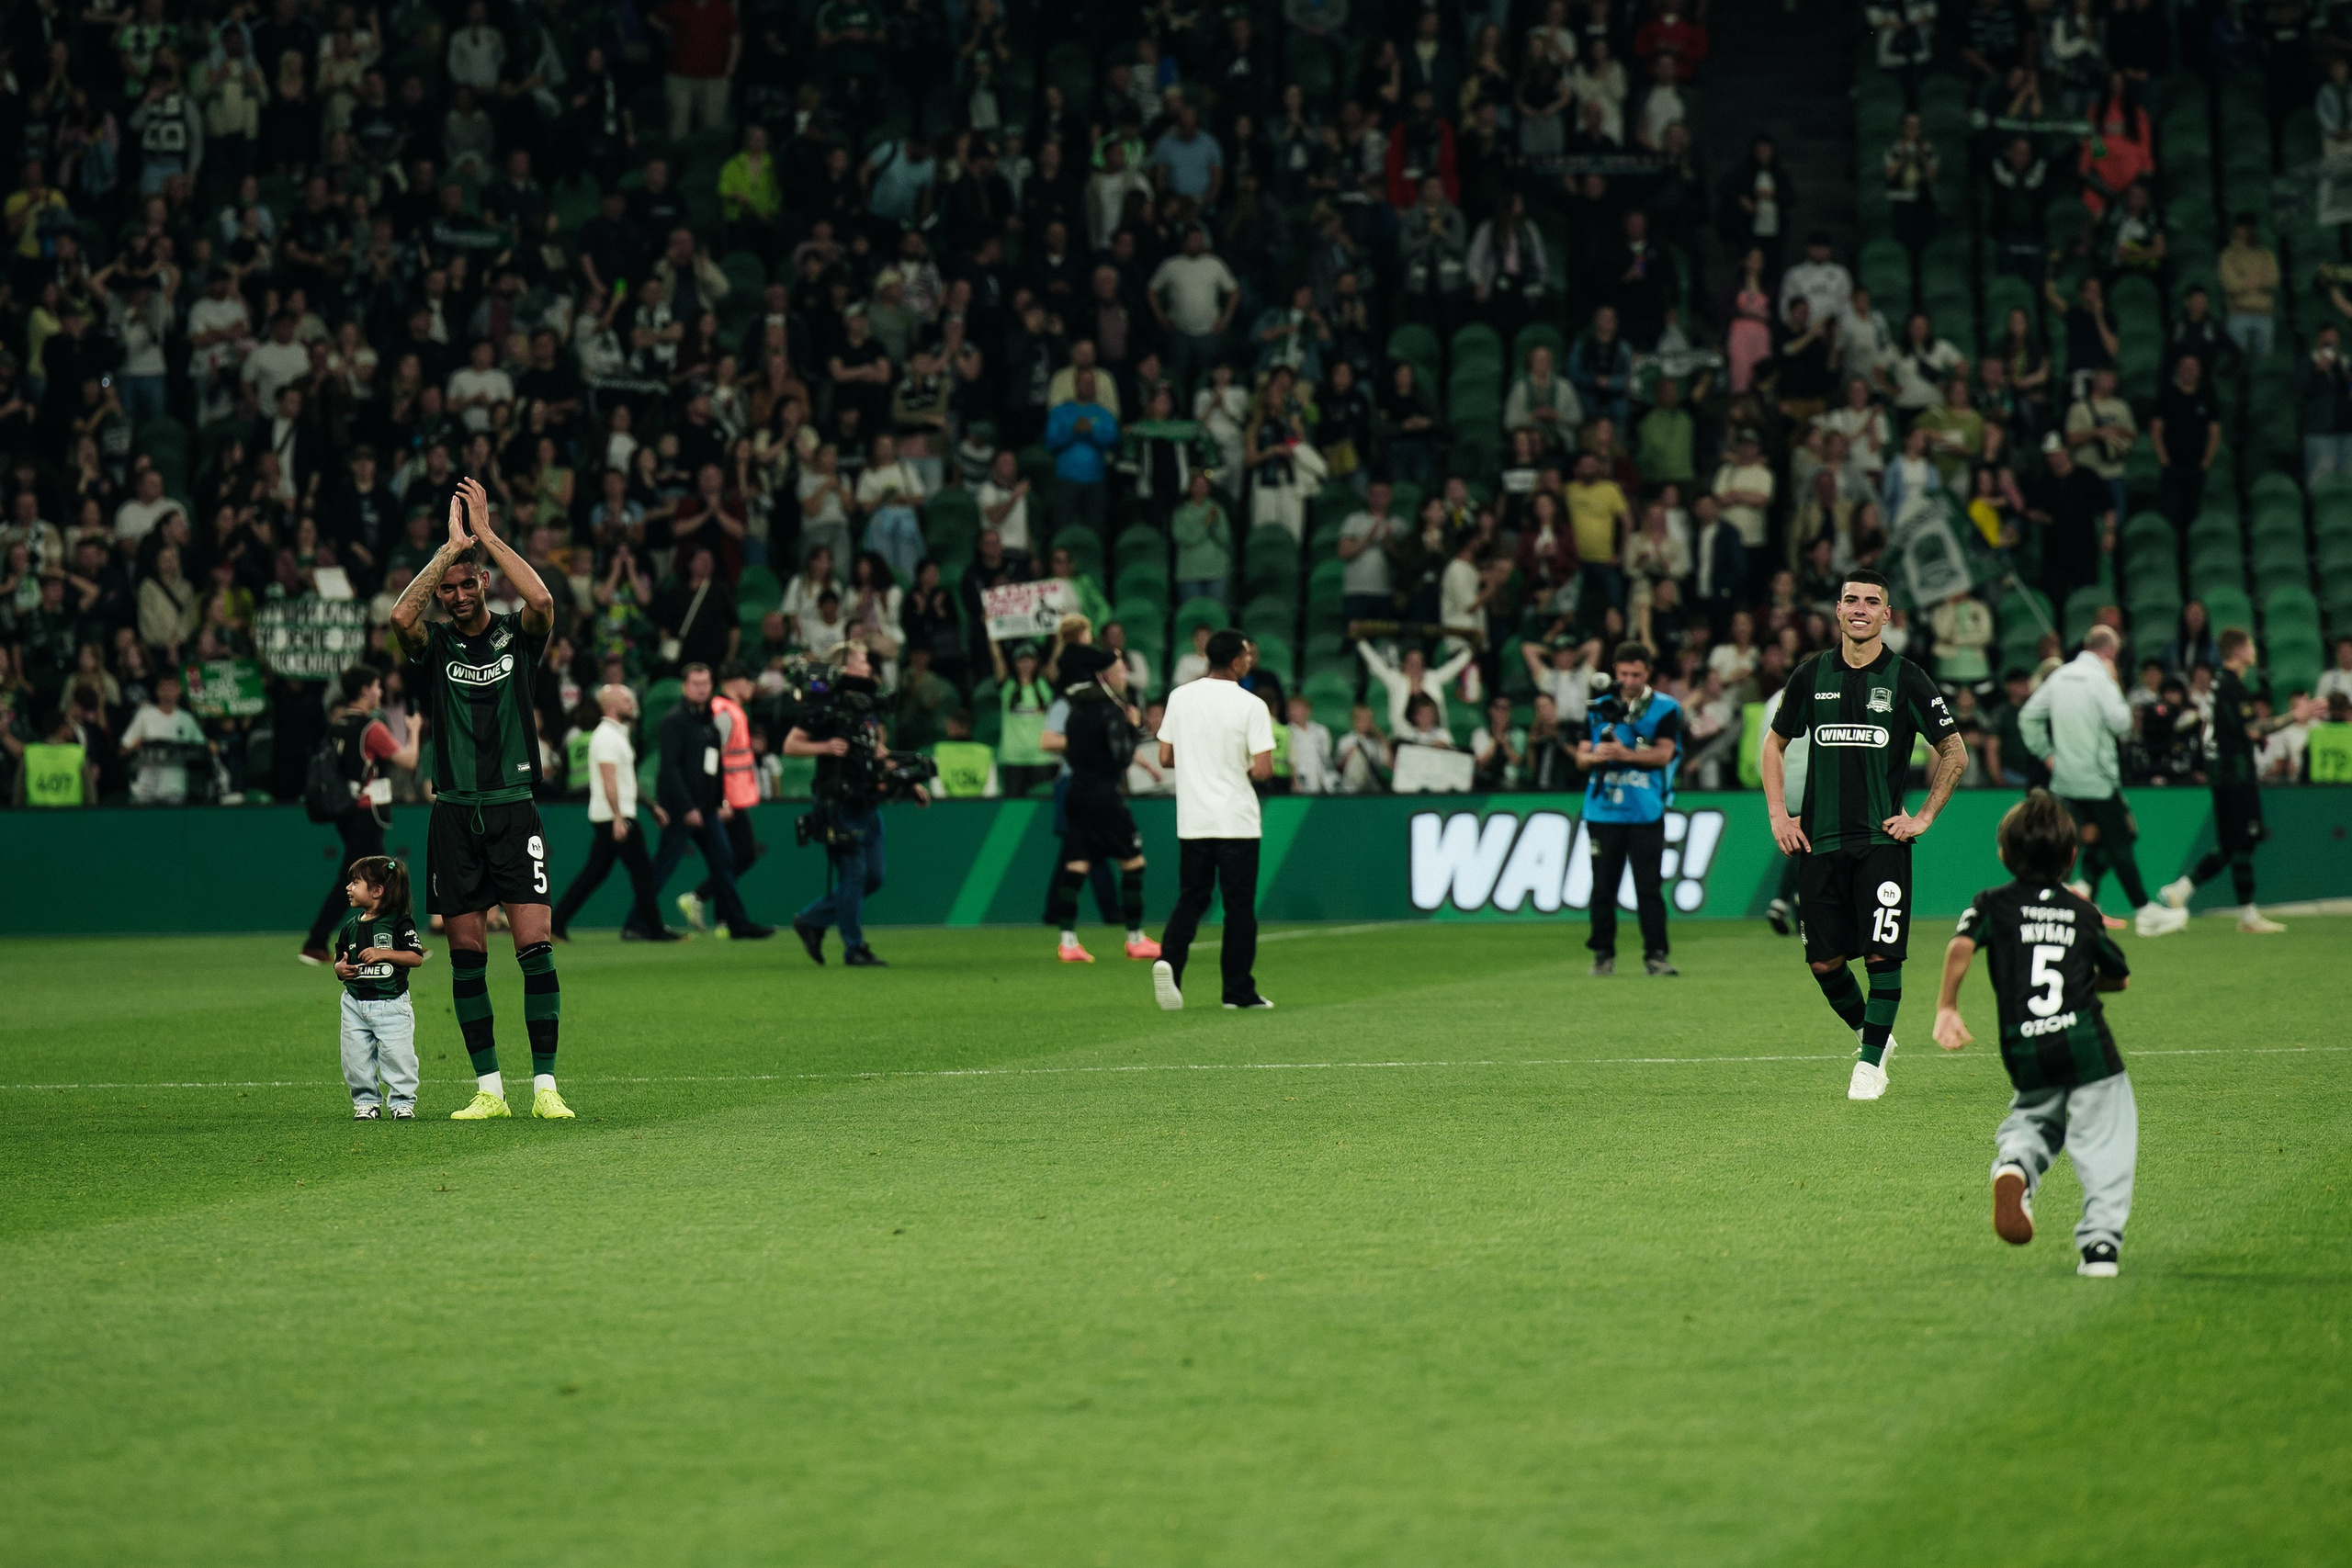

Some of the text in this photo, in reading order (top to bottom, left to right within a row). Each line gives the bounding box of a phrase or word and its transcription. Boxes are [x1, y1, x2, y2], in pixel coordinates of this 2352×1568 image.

[452, 663, 502, 682] WINLINE
[1814, 692, 1841, 701] OZON
[1820, 728, 1873, 742] WINLINE
[533, 860, 548, 894] 5
[1883, 888, 1895, 898] hh
[1872, 907, 1902, 944] 15
[2027, 944, 2065, 1018] 5
[2019, 1011, 2078, 1039] OZON
